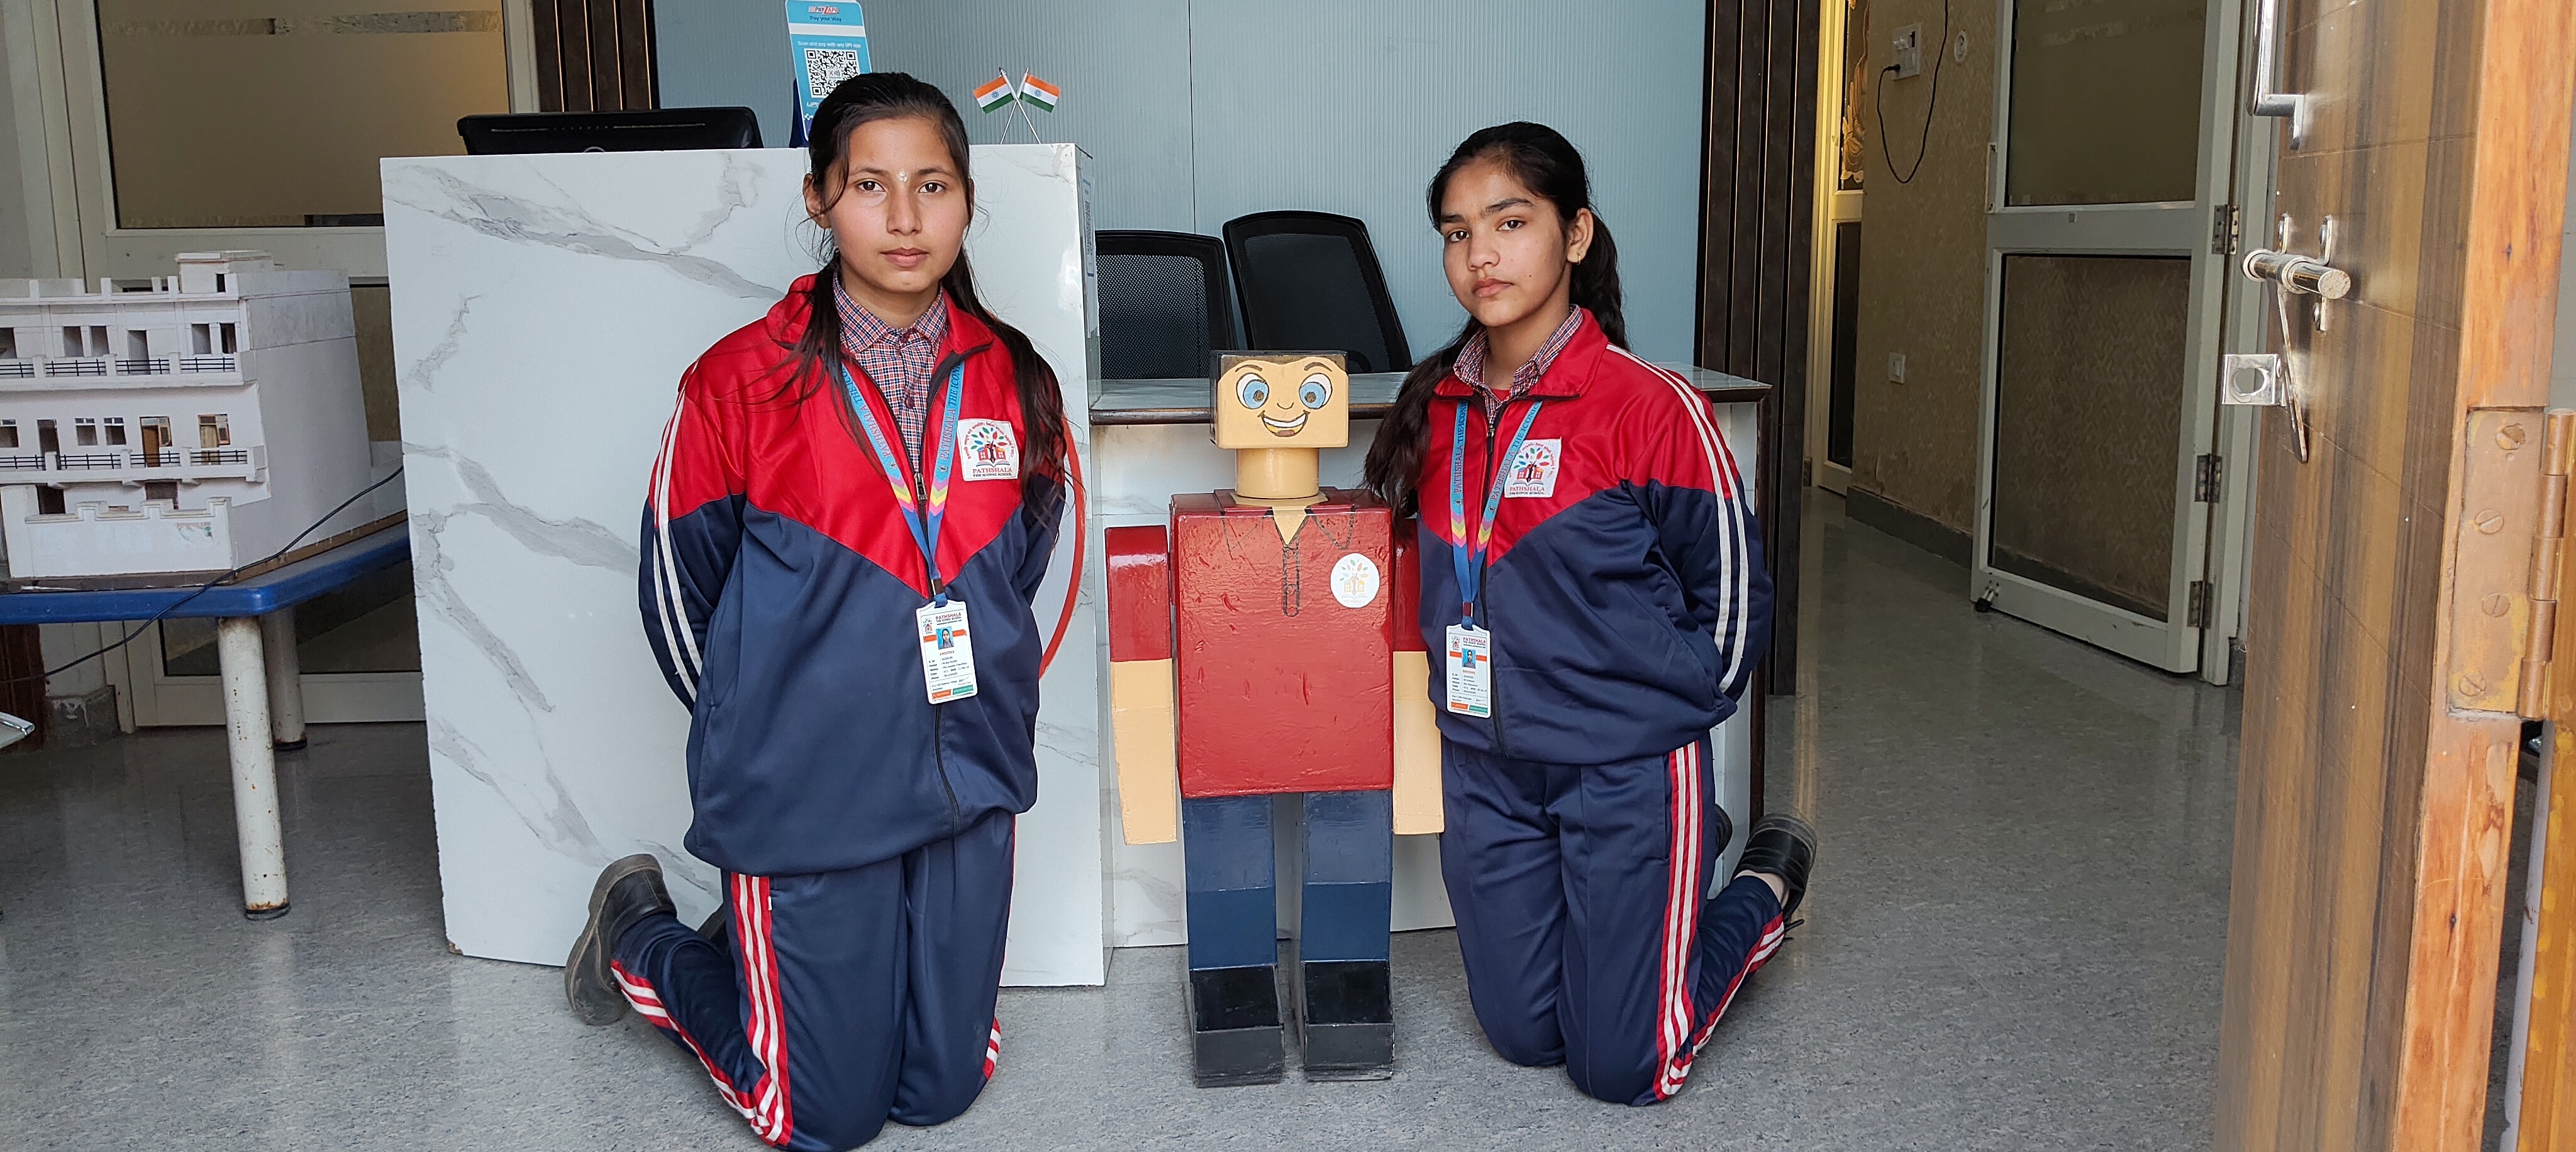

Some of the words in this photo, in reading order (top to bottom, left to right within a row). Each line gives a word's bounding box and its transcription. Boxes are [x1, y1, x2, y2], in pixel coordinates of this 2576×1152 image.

[860, 404, 891, 458] PATHSHALA
[940, 409, 955, 461] PATHSHALA
[948, 389, 958, 406] THE
[1454, 445, 1463, 494] PATHSHALA
[1491, 450, 1516, 501] PATHSHALA
[1512, 432, 1524, 448] THE
[1521, 404, 1539, 432] ICONIC
[935, 612, 962, 620] PATHSHALA
